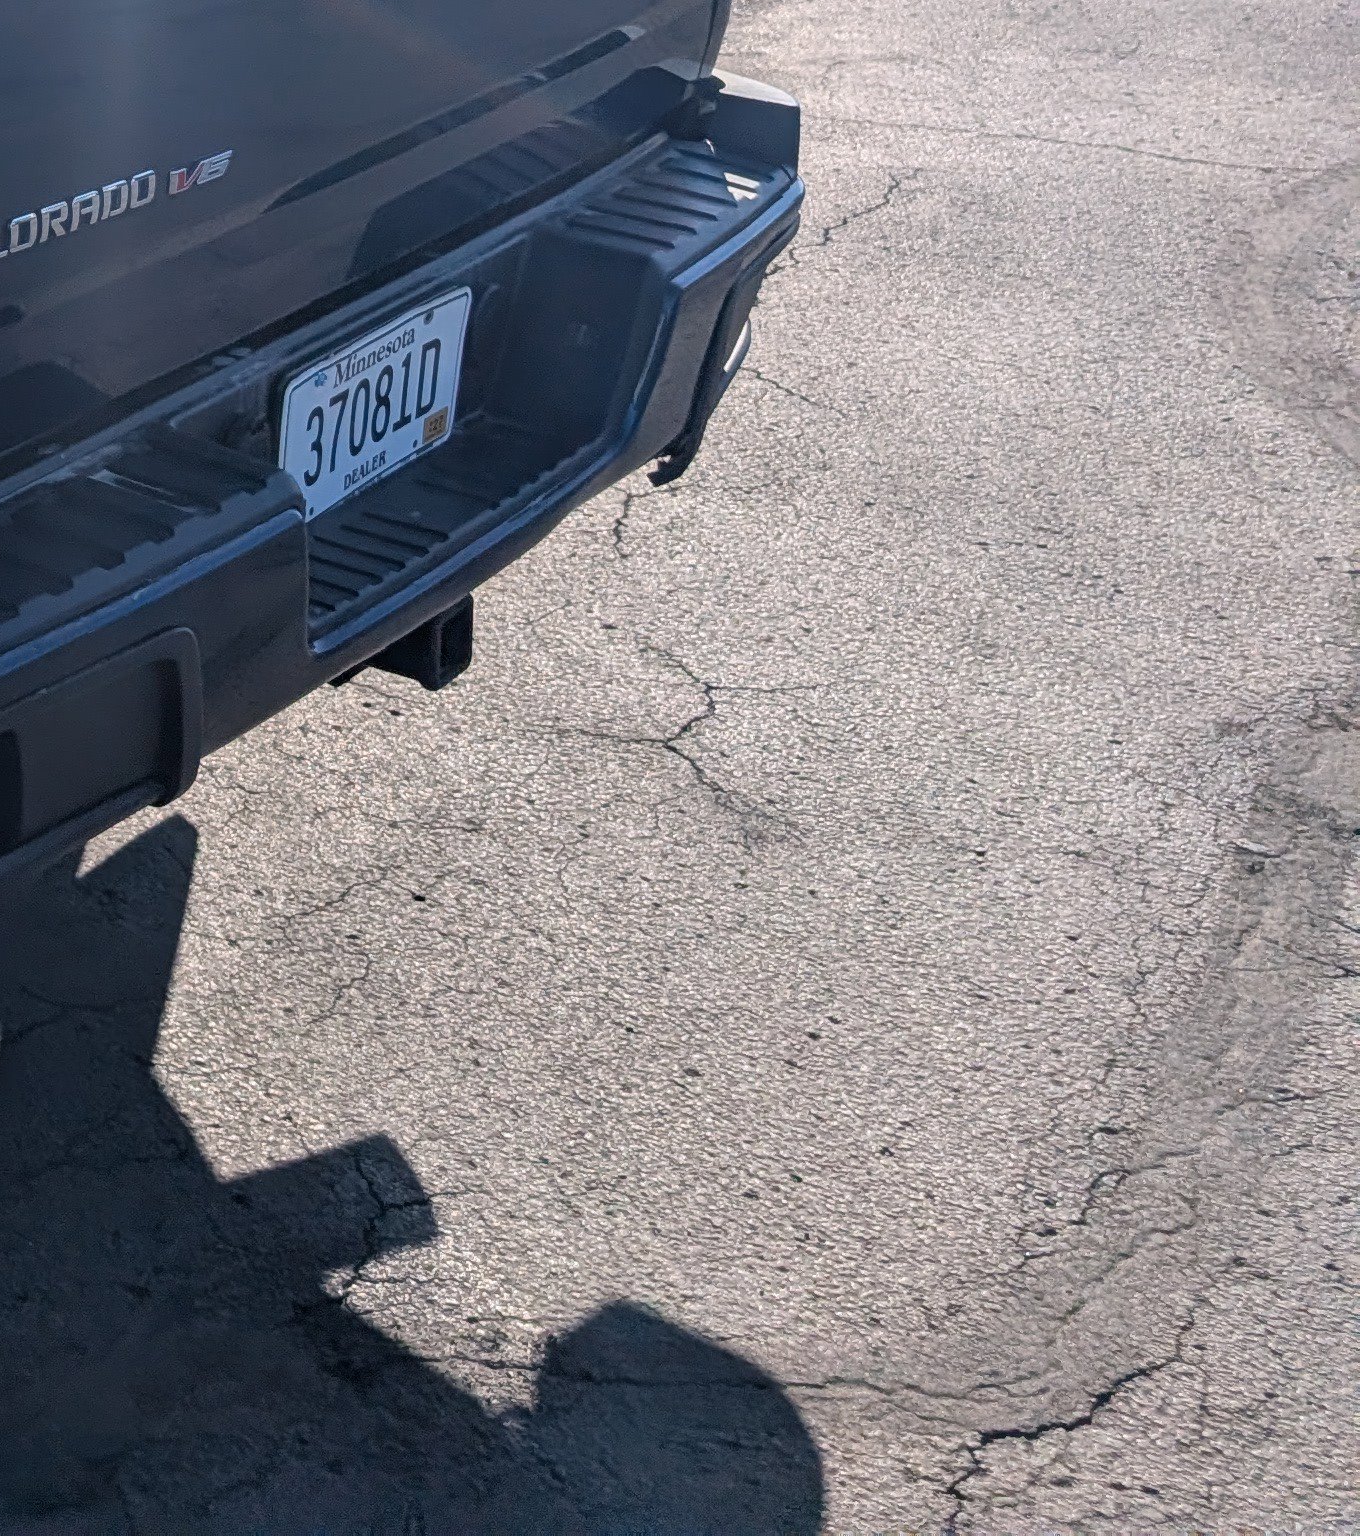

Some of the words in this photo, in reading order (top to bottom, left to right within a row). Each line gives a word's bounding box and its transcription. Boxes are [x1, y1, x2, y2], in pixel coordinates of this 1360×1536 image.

[168, 149, 233, 196] V6
[332, 327, 416, 389] Minnesota
[303, 337, 442, 487] 37081D
[343, 449, 387, 490] DEALER
